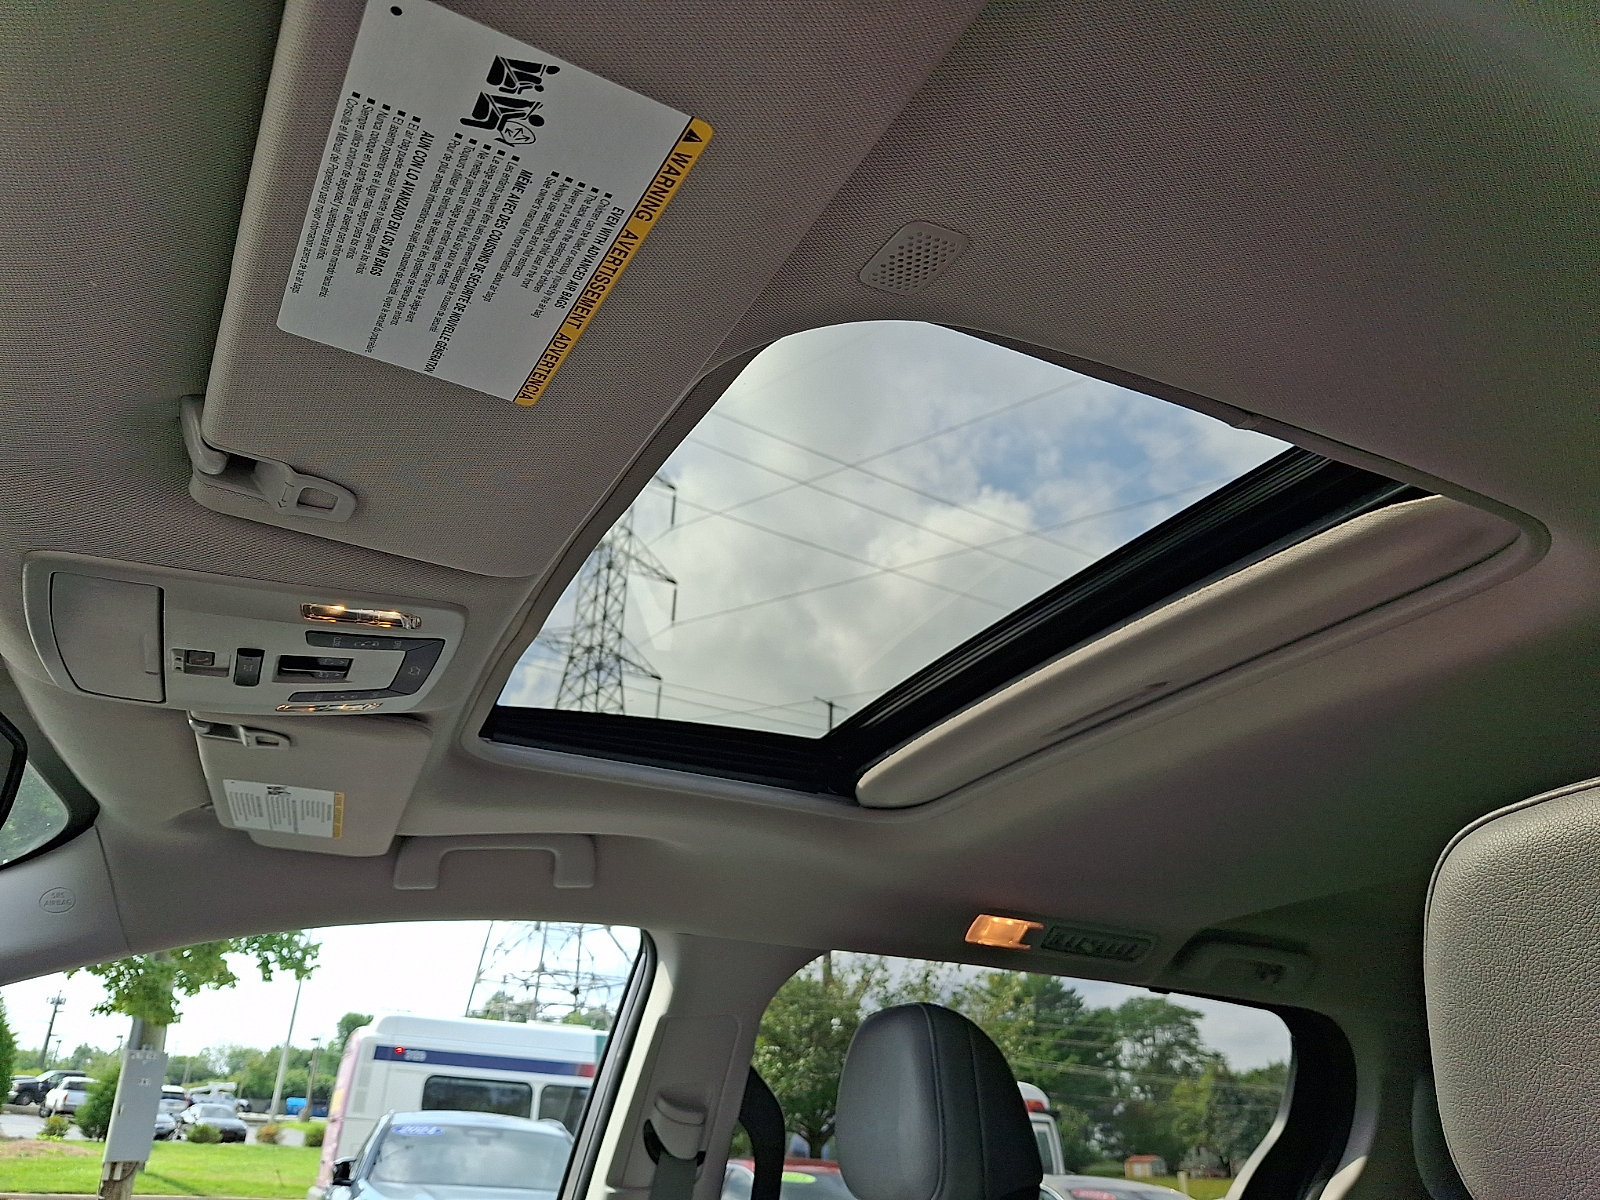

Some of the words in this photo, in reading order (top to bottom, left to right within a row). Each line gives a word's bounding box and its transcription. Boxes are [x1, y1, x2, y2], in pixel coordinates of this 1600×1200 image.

[340, 97, 359, 127] Consulte
[353, 102, 374, 132] Siempre
[373, 110, 390, 132] Nunca
[332, 131, 348, 155] Manual
[350, 129, 366, 149] utilice
[362, 128, 383, 155] coloque
[384, 123, 402, 148] asiento
[396, 137, 413, 153] bag
[416, 129, 435, 151] AUN
[445, 138, 461, 154] Pour
[373, 144, 394, 172] posterior
[390, 149, 409, 170] puede
[409, 148, 427, 169] CON
[453, 142, 475, 170] Toujours
[404, 166, 420, 181] LO
[434, 159, 452, 176] plus
[448, 167, 465, 188] utiliser
[468, 159, 486, 180] mettez
[481, 162, 500, 181] siège
[504, 160, 518, 174] Les
[426, 171, 446, 195] amples
[457, 176, 477, 198] jamais
[476, 178, 493, 199] arrière
[494, 172, 513, 194] enfants
[511, 168, 536, 195] MÊME
[542, 176, 557, 190] See
[549, 180, 570, 203] Always
[634, 153, 692, 222] WARNING
[389, 178, 416, 221] AVANZADO
[482, 190, 503, 215] peuvent
[500, 192, 521, 215] AVEC
[531, 187, 551, 211] owner's
[546, 200, 558, 212] use
[566, 186, 584, 205] Never
[583, 192, 598, 206] The
[521, 208, 540, 229] manual
[539, 211, 554, 225] seat
[575, 203, 591, 219] back
[589, 197, 611, 222] Children
[603, 205, 625, 228] EVEN
[385, 218, 400, 232] EN
[493, 212, 511, 230] DES
[542, 215, 567, 245] rear-facing
[569, 216, 584, 230] seat
[583, 219, 595, 230] can
[379, 229, 396, 246] LOS
[476, 228, 504, 264] COUSSINS
[592, 225, 613, 246] WITH
[375, 244, 390, 258] AIR
[368, 256, 386, 277] BAGS
[472, 261, 487, 274] DE
[570, 243, 602, 281] ADVANCED
[457, 271, 484, 305] SÉCURITÉ
[563, 278, 580, 292] AIR
[568, 229, 639, 330] AVERTISSEMENT
[452, 301, 467, 312] DE
[553, 290, 573, 310] BAGS
[438, 310, 462, 342] NOUVELLE
[422, 339, 450, 374] GÉNÉRATION
[518, 333, 572, 401] ADVERTENCIA
